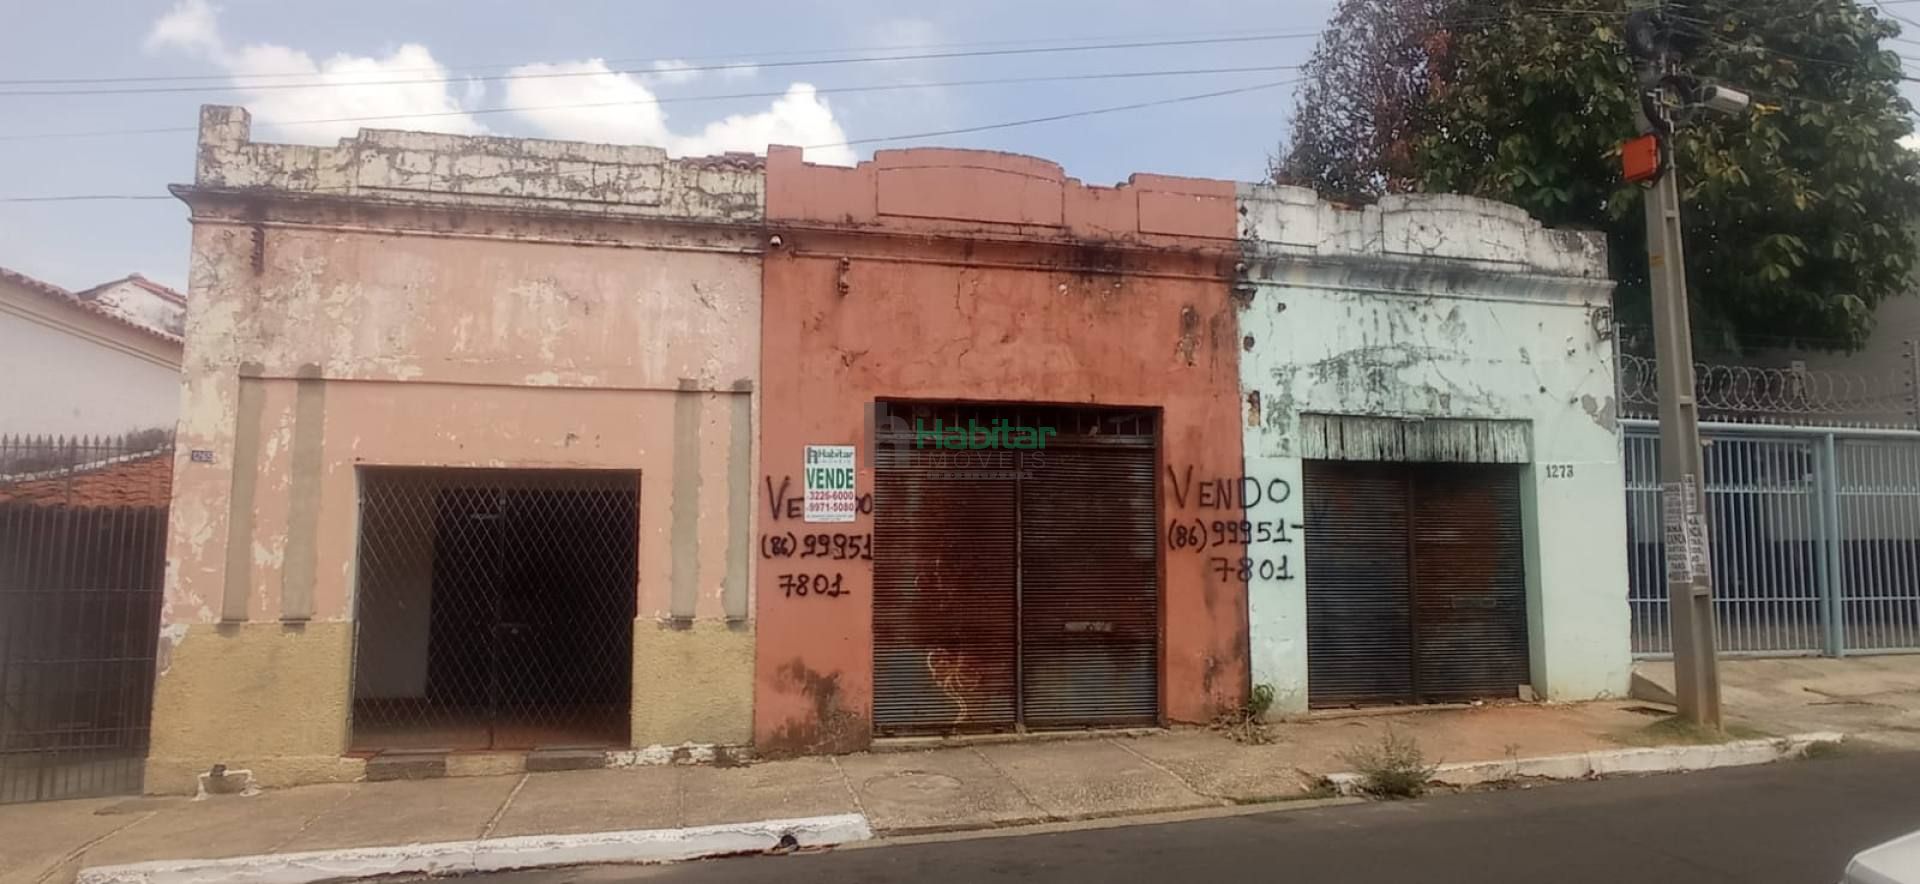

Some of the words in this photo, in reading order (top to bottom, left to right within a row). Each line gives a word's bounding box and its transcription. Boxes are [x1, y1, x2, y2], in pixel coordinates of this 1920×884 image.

[806, 468, 853, 489] VENDE
[1546, 464, 1574, 479] 1273
[1167, 464, 1290, 510] VENDO
[1211, 555, 1294, 583] 7801
[778, 572, 851, 598] 7801
